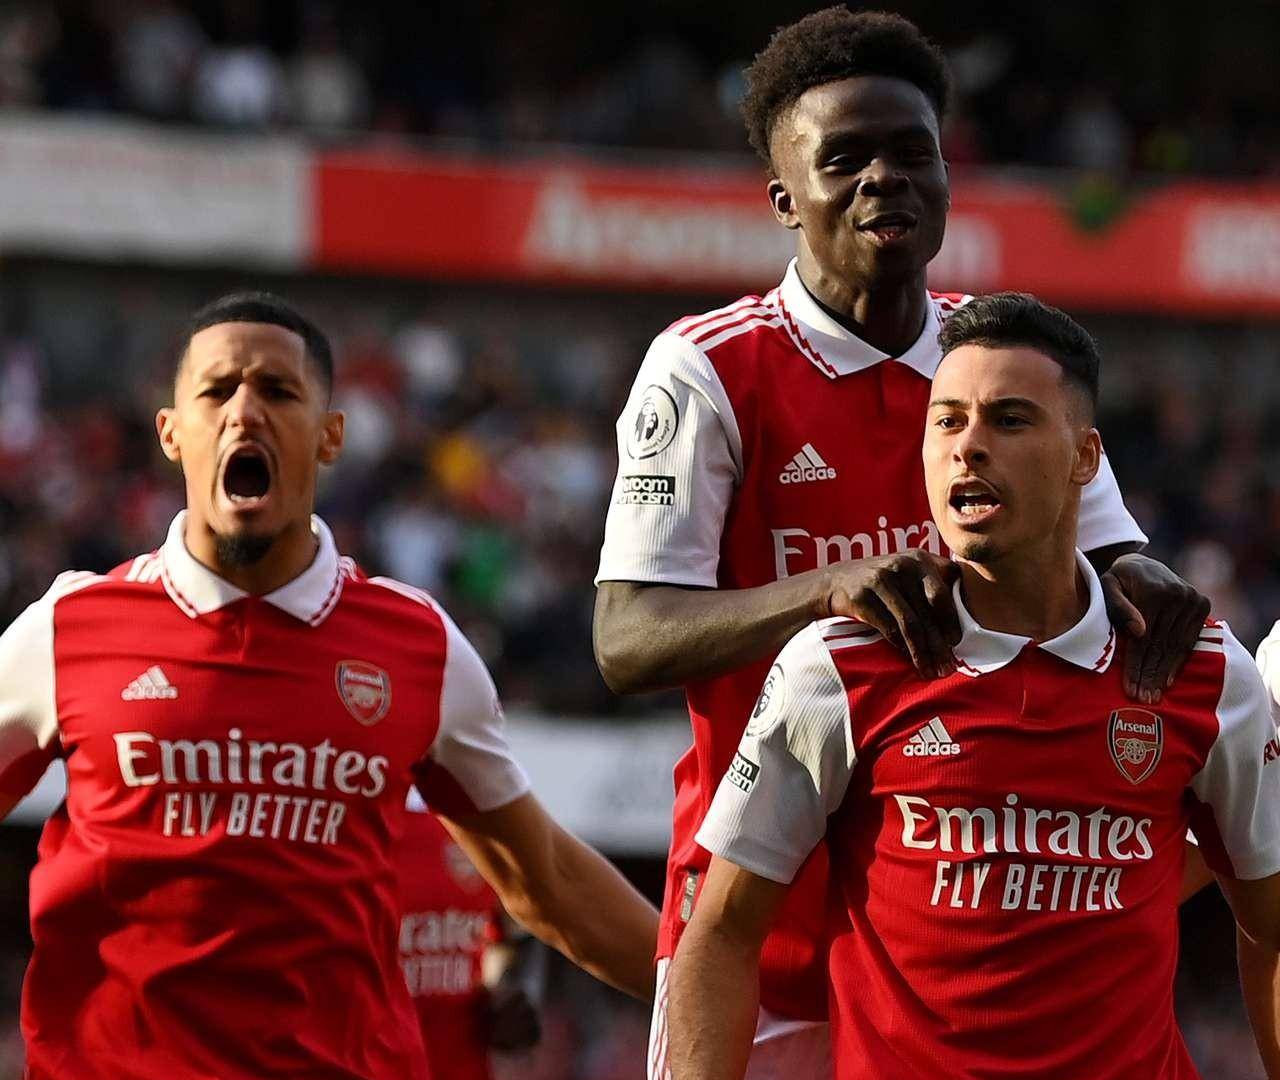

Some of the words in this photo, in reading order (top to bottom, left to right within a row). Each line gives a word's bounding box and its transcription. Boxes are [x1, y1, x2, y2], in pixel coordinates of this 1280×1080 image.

[779, 467, 837, 485] adidas
[771, 515, 956, 580] Emira
[902, 740, 961, 757] adidas
[1115, 718, 1157, 735] Arsenal
[113, 728, 389, 798] Emirates
[163, 791, 217, 837] FLY
[226, 792, 347, 845] BETTER
[893, 793, 1154, 861] Emirates
[930, 860, 991, 909] FLY
[1001, 863, 1124, 912] BETTER
